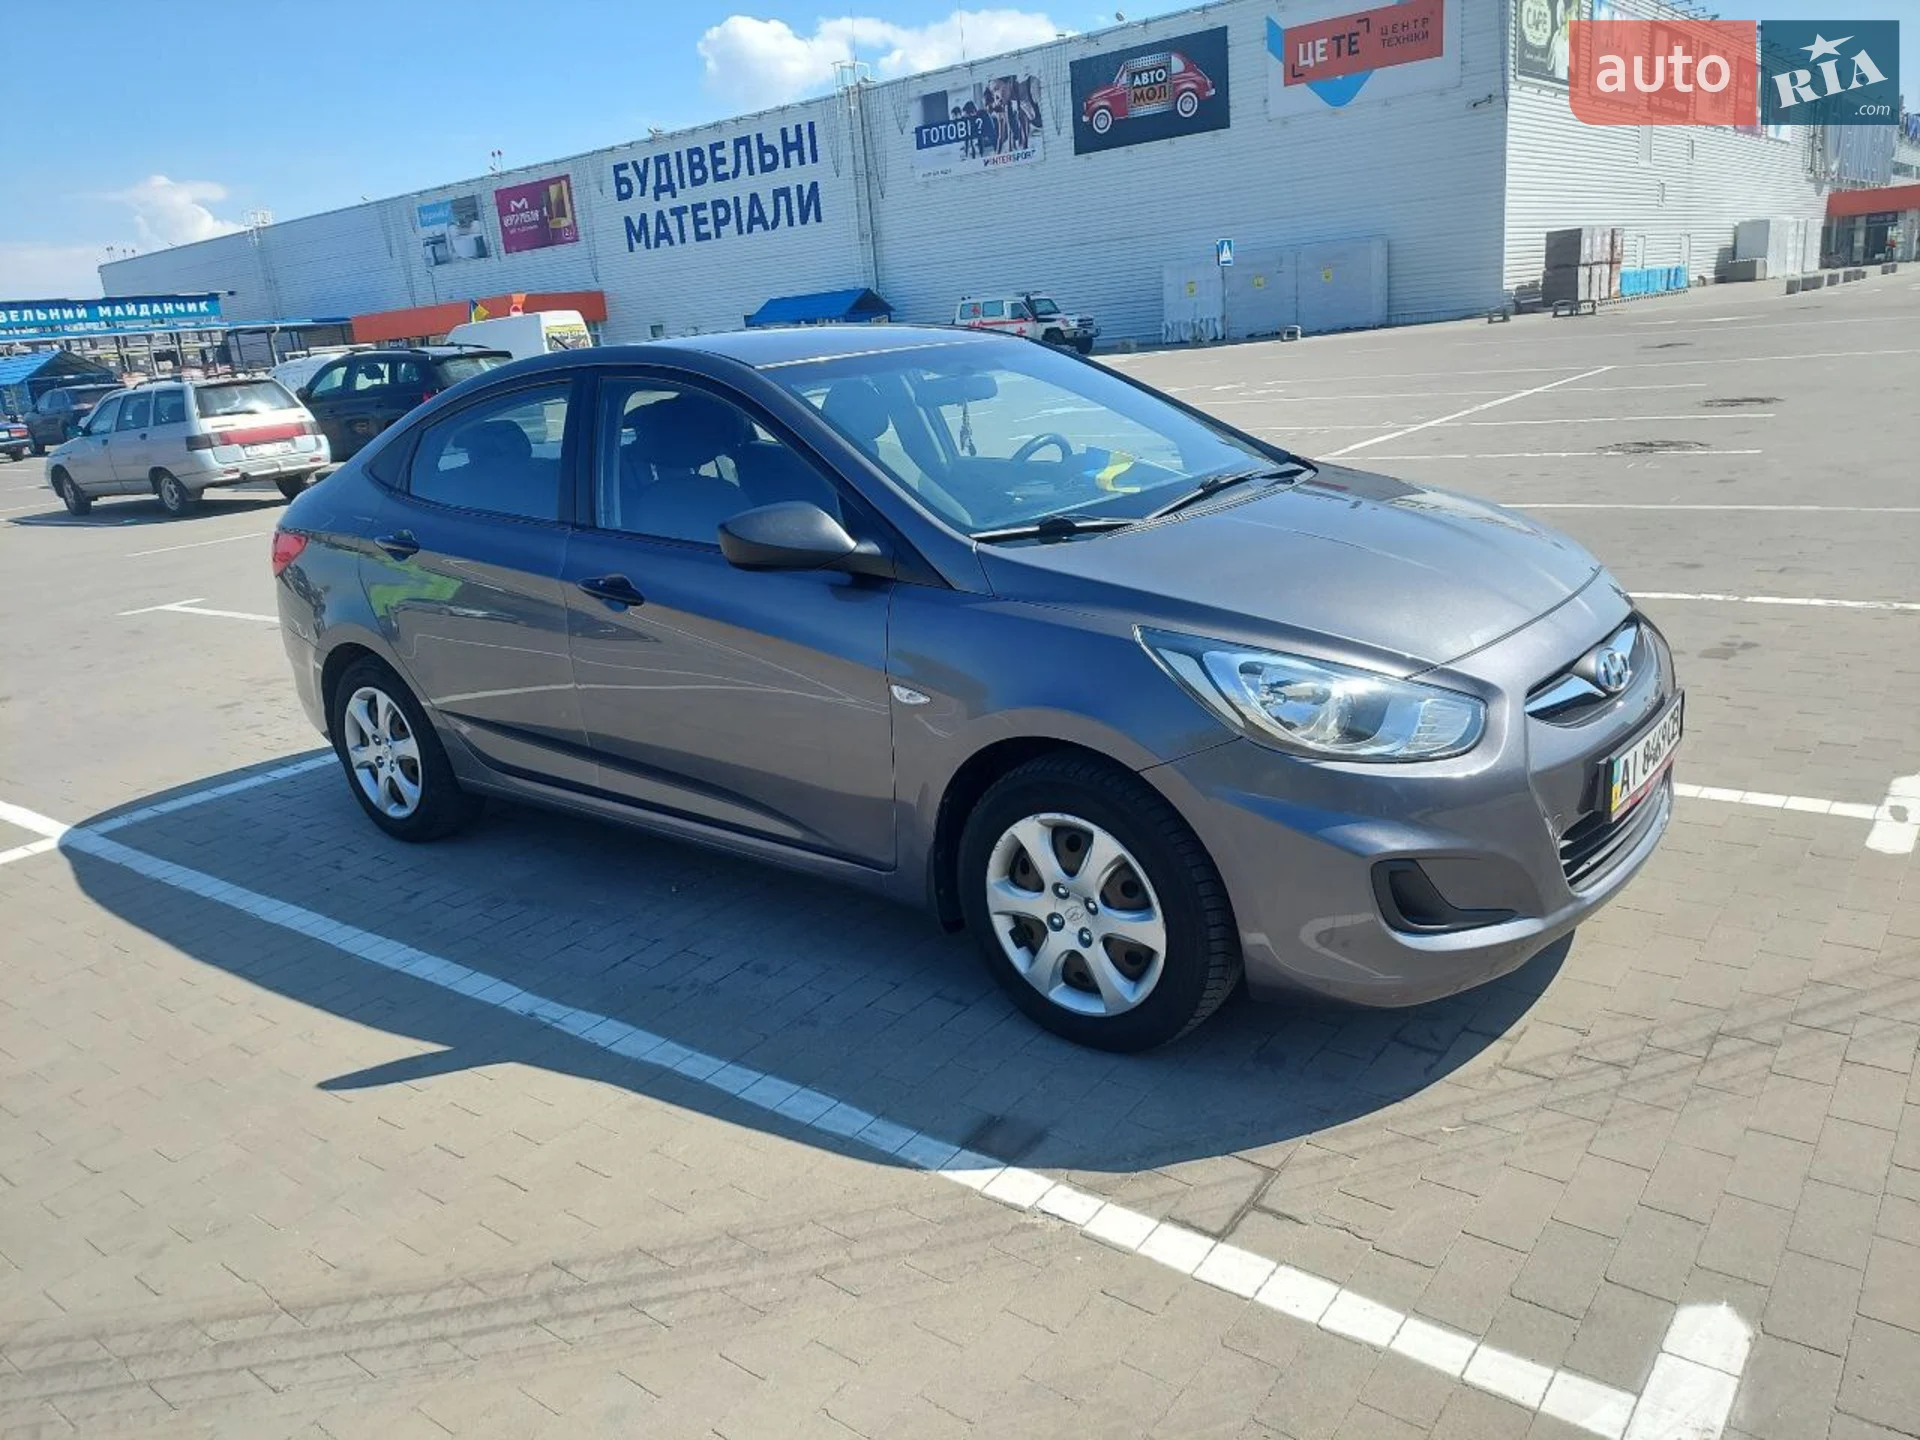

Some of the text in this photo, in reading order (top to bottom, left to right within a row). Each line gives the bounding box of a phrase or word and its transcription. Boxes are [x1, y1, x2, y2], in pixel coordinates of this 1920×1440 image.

[1381, 17, 1430, 36] ЦЕНТР
[1380, 30, 1430, 49] ТЕХНІКИ
[1133, 69, 1166, 86] АВТО
[1133, 85, 1167, 104] МОЛ
[921, 118, 972, 145] ГОТОВІ
[613, 121, 818, 201] БУДІВЕЛЬНІ
[624, 181, 823, 252] МАТЕРІАЛИ
[98, 301, 209, 319] МАЙДАНЧИК
